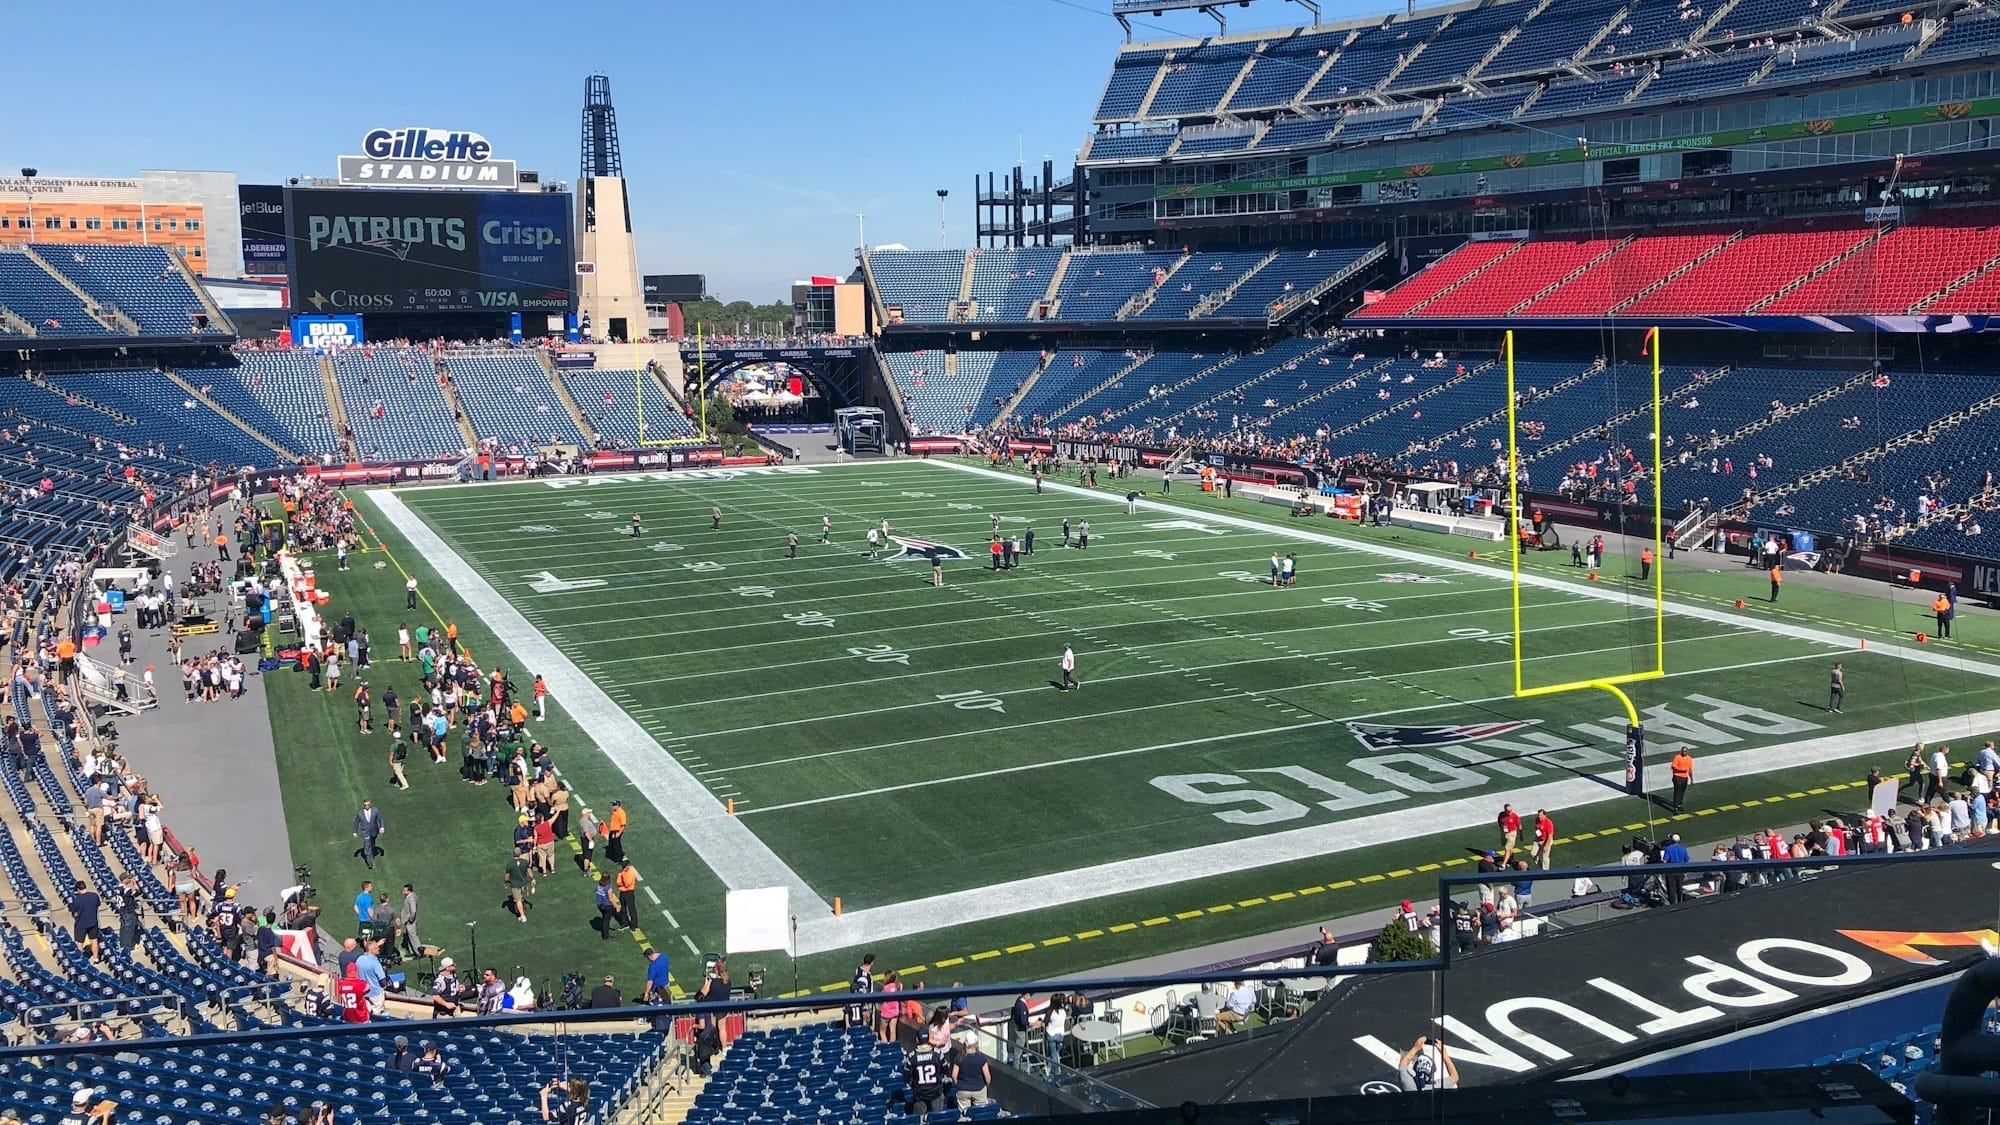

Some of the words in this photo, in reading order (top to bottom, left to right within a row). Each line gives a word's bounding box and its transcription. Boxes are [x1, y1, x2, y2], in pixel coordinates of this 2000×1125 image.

[364, 129, 490, 161] Gillette
[1590, 145, 1622, 157] OFFICIAL
[1625, 143, 1656, 154] FRENCH
[1656, 140, 1673, 150] FRY
[1677, 137, 1712, 148] SPONSOR
[359, 163, 499, 181] STADIUM
[1251, 181, 1279, 190] OFFICIAL
[1281, 179, 1307, 188] FRENCH
[1320, 175, 1347, 185] SPONSOR
[241, 201, 283, 216] jetBlue
[308, 215, 466, 252] PATRIOTS
[482, 220, 562, 249] Crisp.
[243, 244, 286, 252] J.DERENZO
[502, 255, 519, 263] BUD
[520, 255, 544, 263] LIGHT
[330, 289, 394, 307] CROSS
[408, 296, 415, 304] 0
[424, 288, 452, 298] 60:00
[461, 296, 468, 304] 0
[476, 291, 519, 307] VISA
[523, 300, 568, 308] EMPOWER
[309, 323, 348, 336] BUD
[302, 335, 355, 348] LIGHT
[782, 611, 836, 627] 30
[846, 645, 910, 663] 20
[935, 689, 1003, 710] 10
[1149, 693, 1828, 825] PATRIOTS
[219, 912, 234, 926] 33
[1408, 917, 1418, 932] 11
[306, 1000, 318, 1016] 12
[341, 992, 358, 1009] 12
[851, 1006, 861, 1021] 11
[1352, 937, 1873, 1086] OPTUM
[915, 1064, 937, 1085] 12
